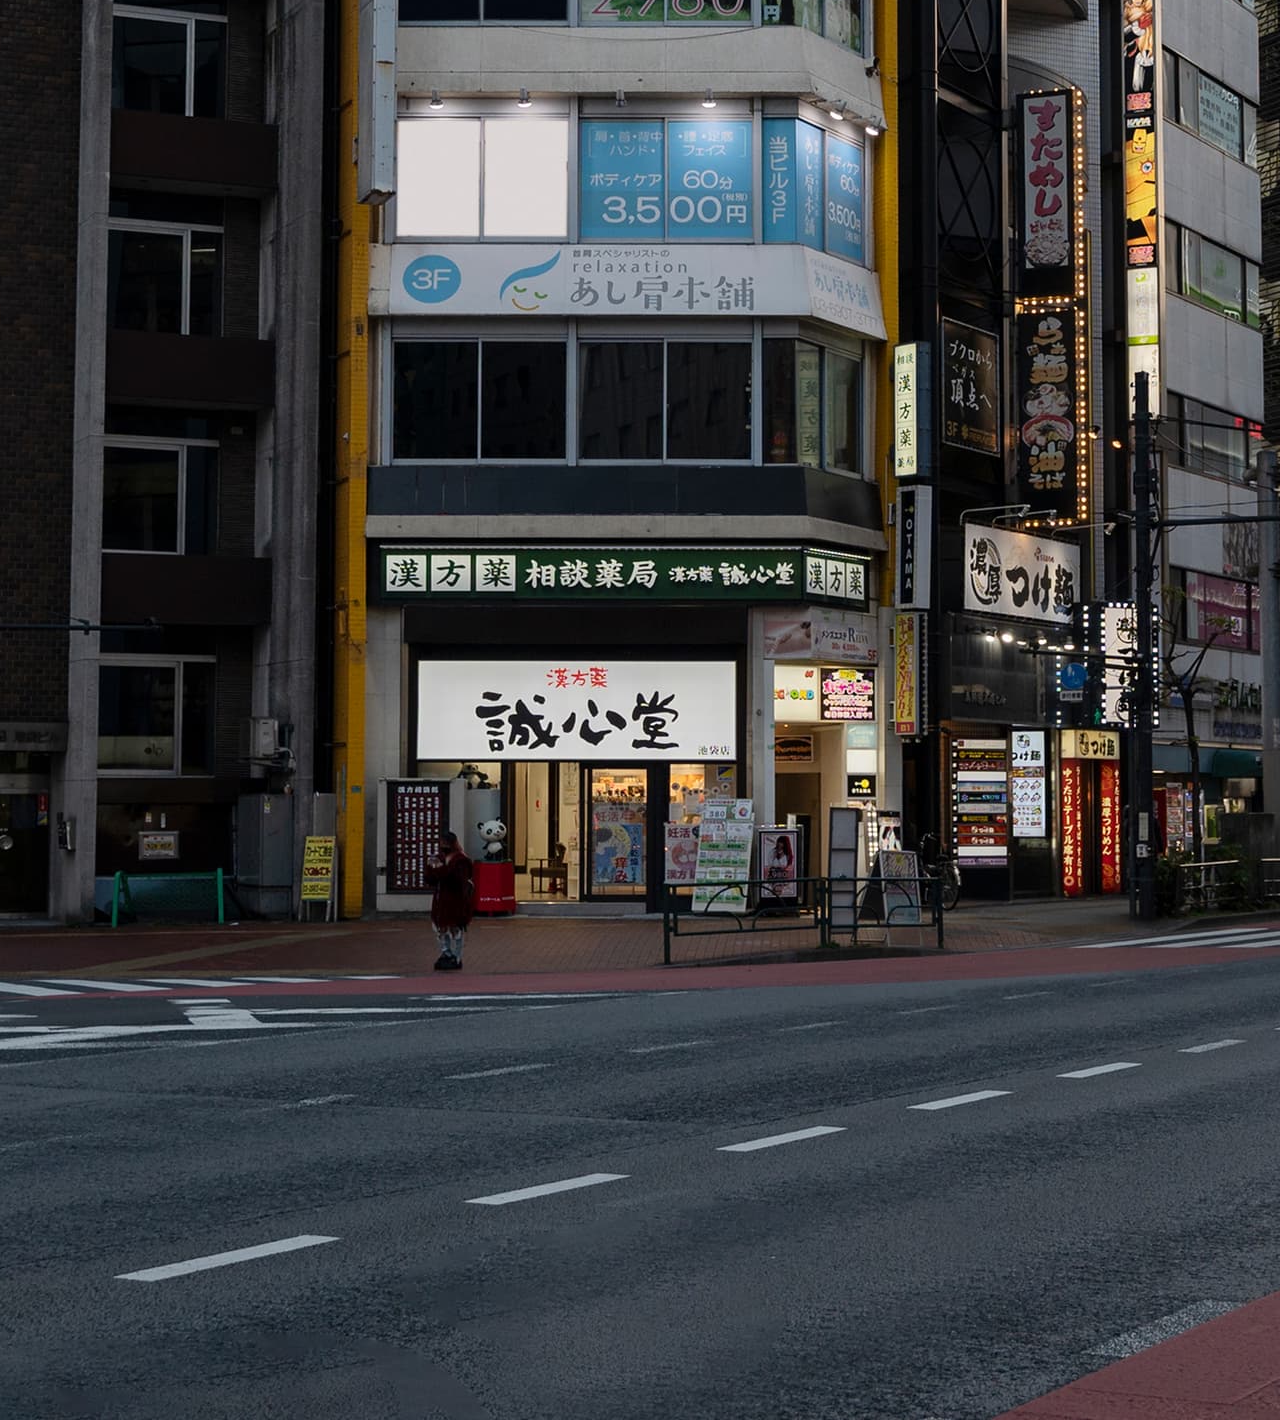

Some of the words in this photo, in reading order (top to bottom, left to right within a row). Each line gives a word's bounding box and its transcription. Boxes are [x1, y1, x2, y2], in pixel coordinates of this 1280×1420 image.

[763, 4, 780, 21] 円
[682, 169, 733, 190] 60分
[769, 136, 789, 225] 当ビル3F
[602, 196, 747, 225] 3,500円
[411, 268, 453, 290] 3F
[572, 260, 689, 274] relaxation
[898, 374, 912, 448] 漢方薬
[905, 518, 913, 589] OTAMA
[390, 558, 512, 587] 漢方薬
[524, 558, 659, 589] 相談薬局
[669, 565, 714, 583] 漢方薬
[718, 561, 796, 587] 誠心堂
[807, 562, 864, 596] 漢方薬
[1006, 563, 1075, 617] つけ麺
[546, 666, 609, 689] 漢方薬
[475, 690, 680, 751] 誠心堂
[697, 744, 731, 756] 池袋店
[1090, 737, 1115, 757] つけ麺
